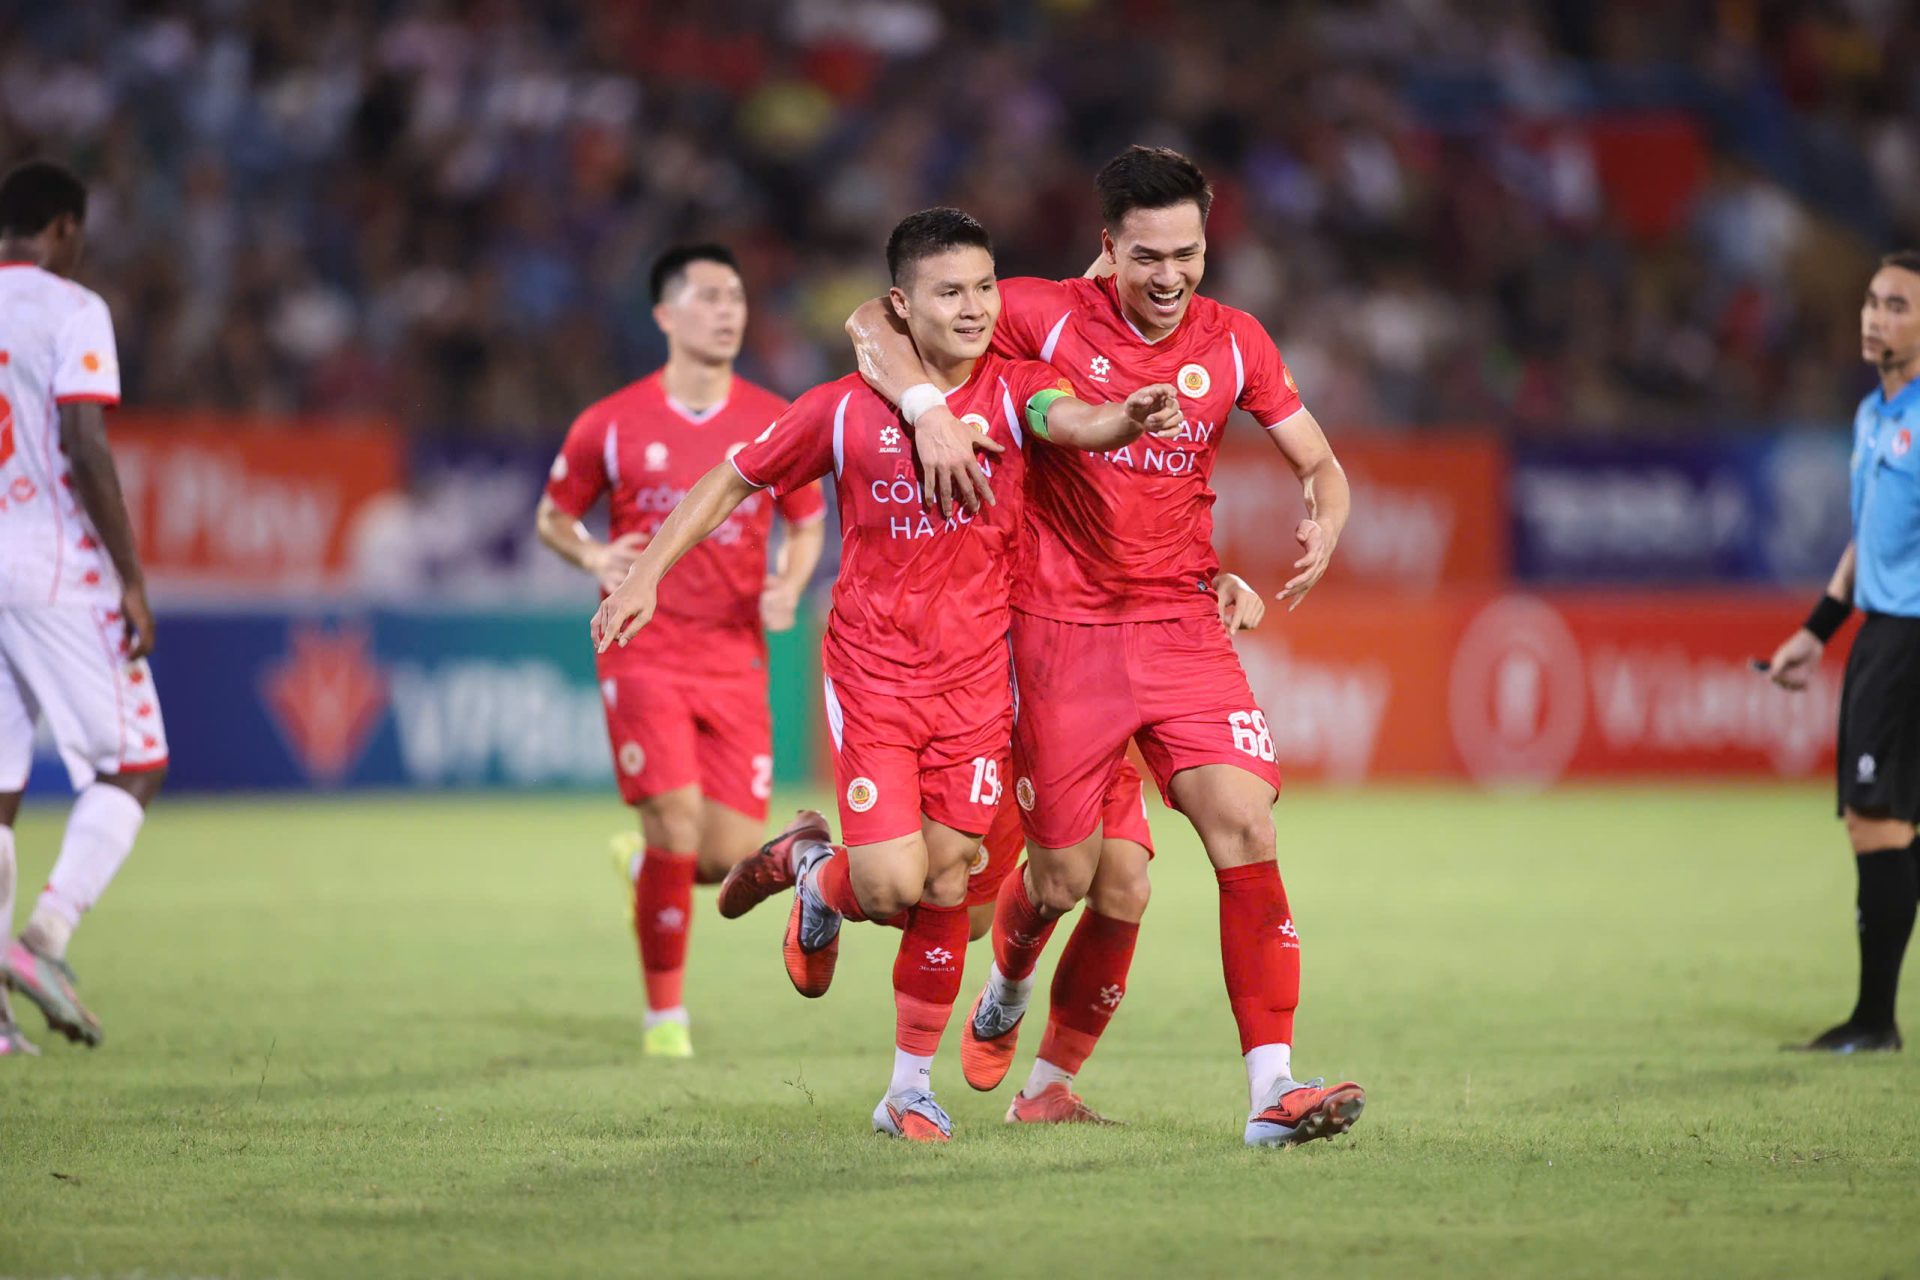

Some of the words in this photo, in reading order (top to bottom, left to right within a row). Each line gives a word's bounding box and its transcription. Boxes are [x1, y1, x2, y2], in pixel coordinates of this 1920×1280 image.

[1172, 419, 1214, 442] AN
[1143, 447, 1196, 477] NỘI
[890, 510, 935, 540] HÀ
[1227, 709, 1276, 763] 68
[969, 756, 998, 806] 19
